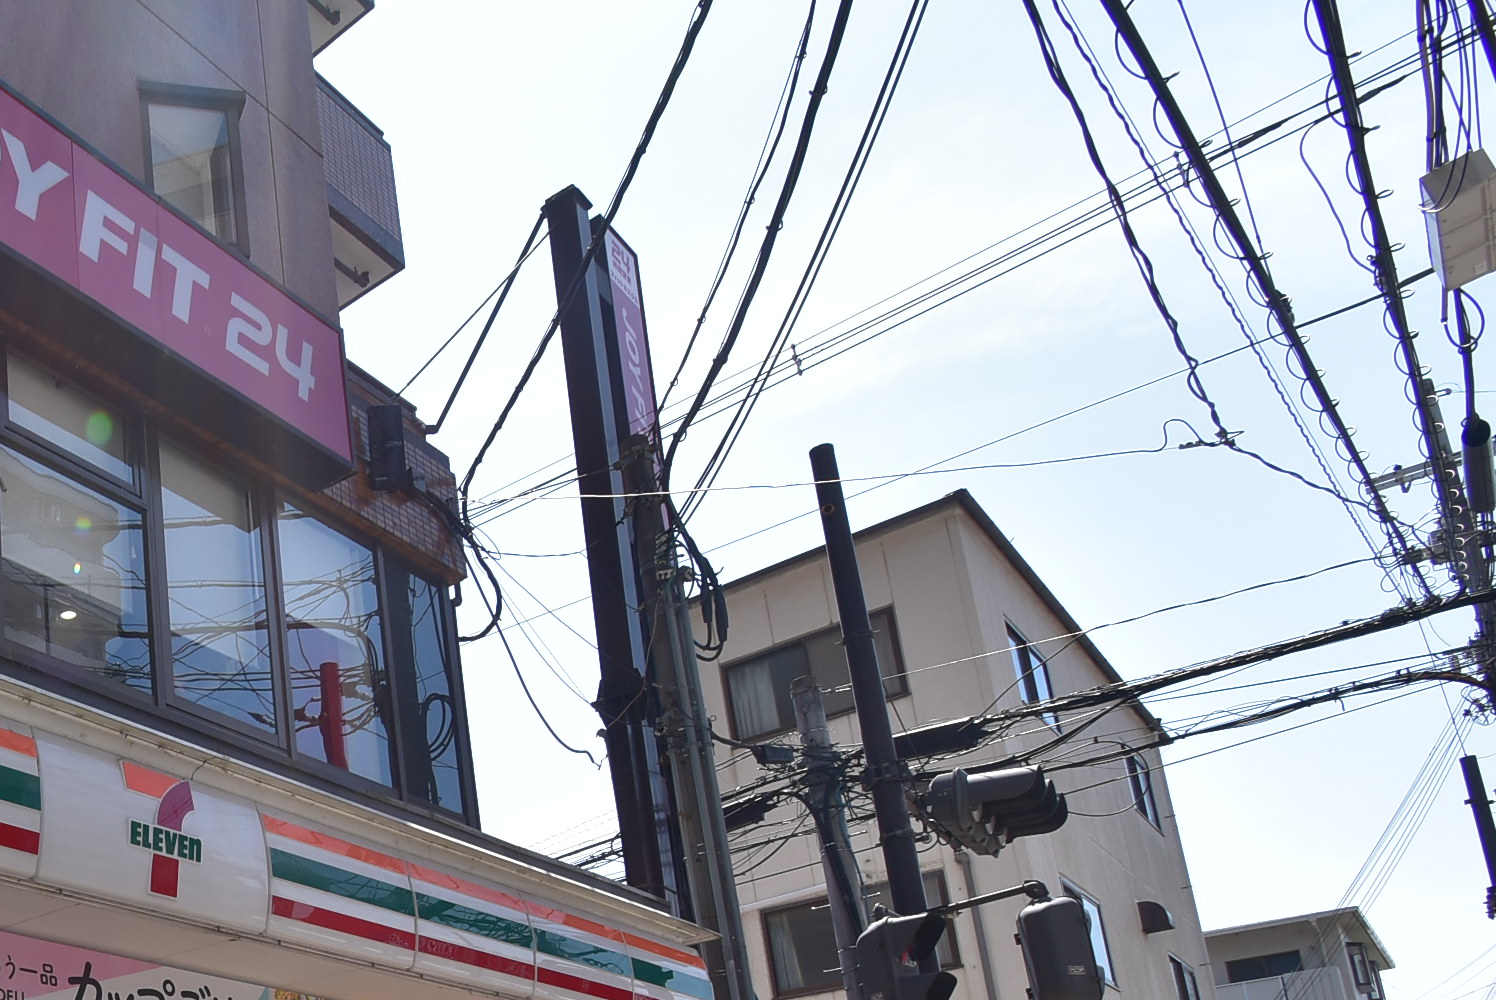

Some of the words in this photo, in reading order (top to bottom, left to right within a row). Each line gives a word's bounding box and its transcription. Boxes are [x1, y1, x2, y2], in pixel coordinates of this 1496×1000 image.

[79, 189, 210, 324] FIT
[225, 294, 316, 402] 24
[621, 306, 642, 392] JOY
